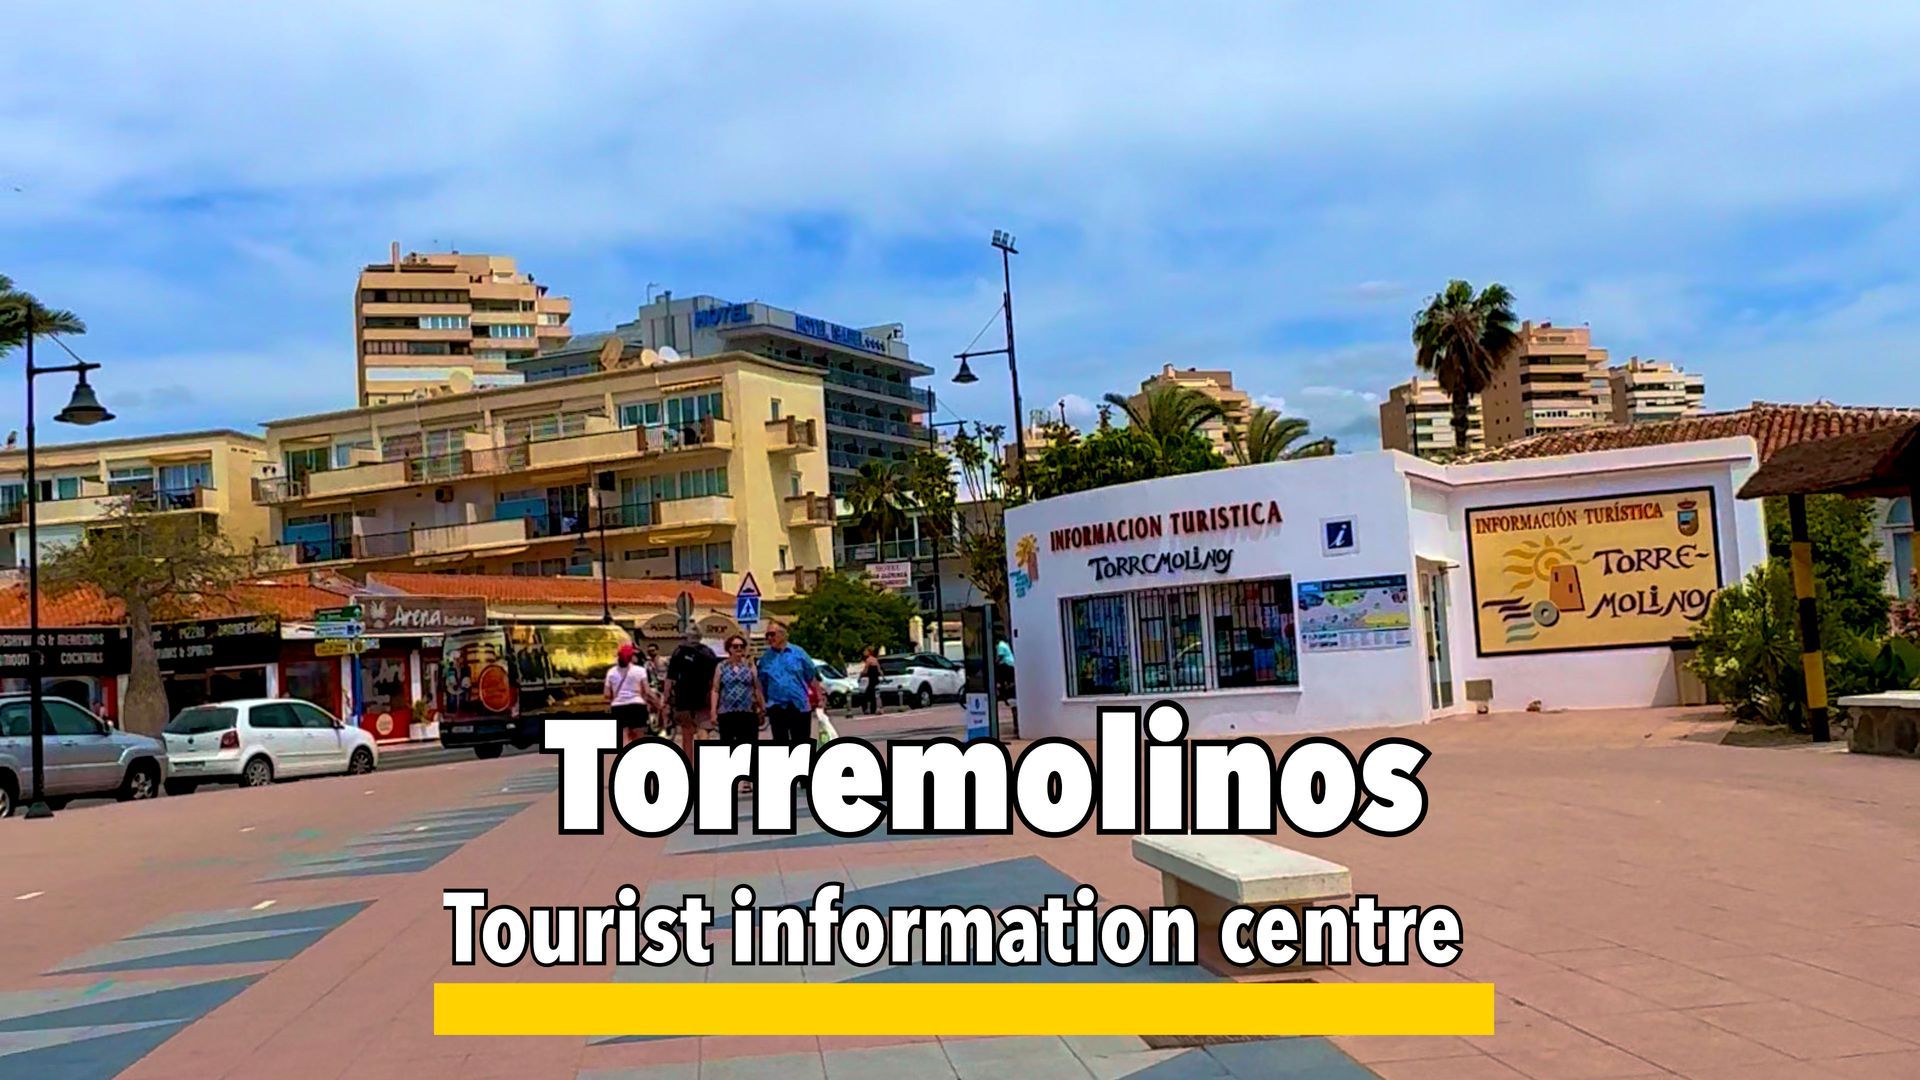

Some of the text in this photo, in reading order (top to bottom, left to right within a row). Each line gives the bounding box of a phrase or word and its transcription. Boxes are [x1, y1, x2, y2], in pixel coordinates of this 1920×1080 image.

[694, 303, 754, 328] HOTEL
[1050, 501, 1283, 551] INFORMACION TURISTICA
[1475, 501, 1663, 534] INFORMACIÓN TURÍSTICA
